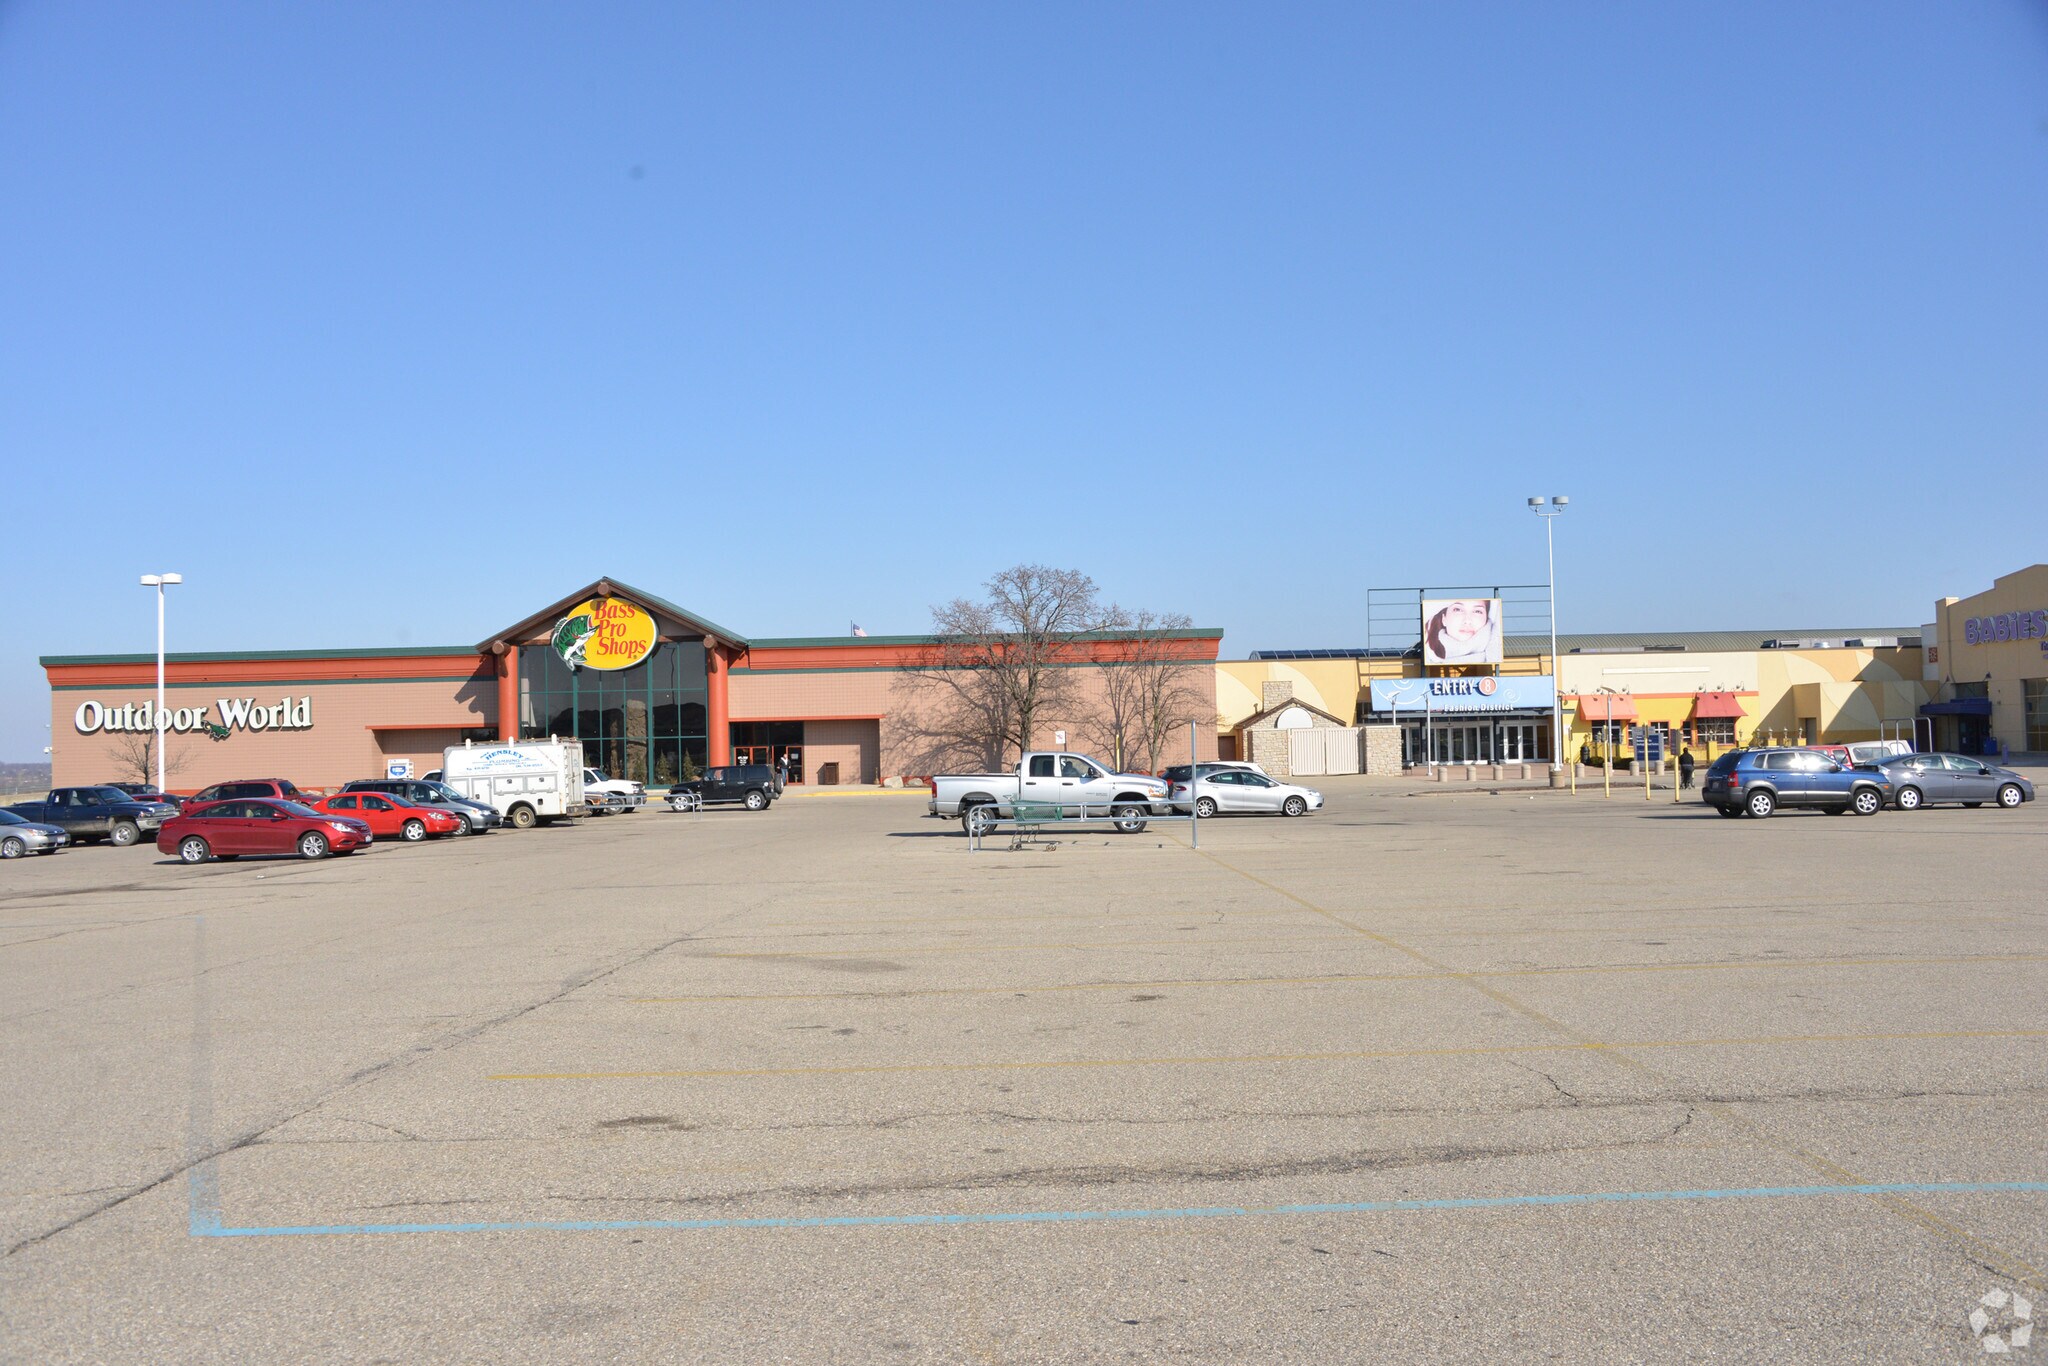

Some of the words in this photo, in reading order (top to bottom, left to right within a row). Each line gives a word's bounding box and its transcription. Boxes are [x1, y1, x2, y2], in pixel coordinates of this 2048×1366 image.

[594, 601, 636, 620] Bass
[597, 619, 627, 638] Pro
[596, 636, 647, 659] Shops
[1434, 679, 1474, 695] ENTRY
[75, 700, 207, 732] Outdoor
[217, 696, 313, 729] World
[1444, 703, 1479, 712] Fashion
[1480, 702, 1514, 711] District
[485, 749, 524, 760] HENSLEY
